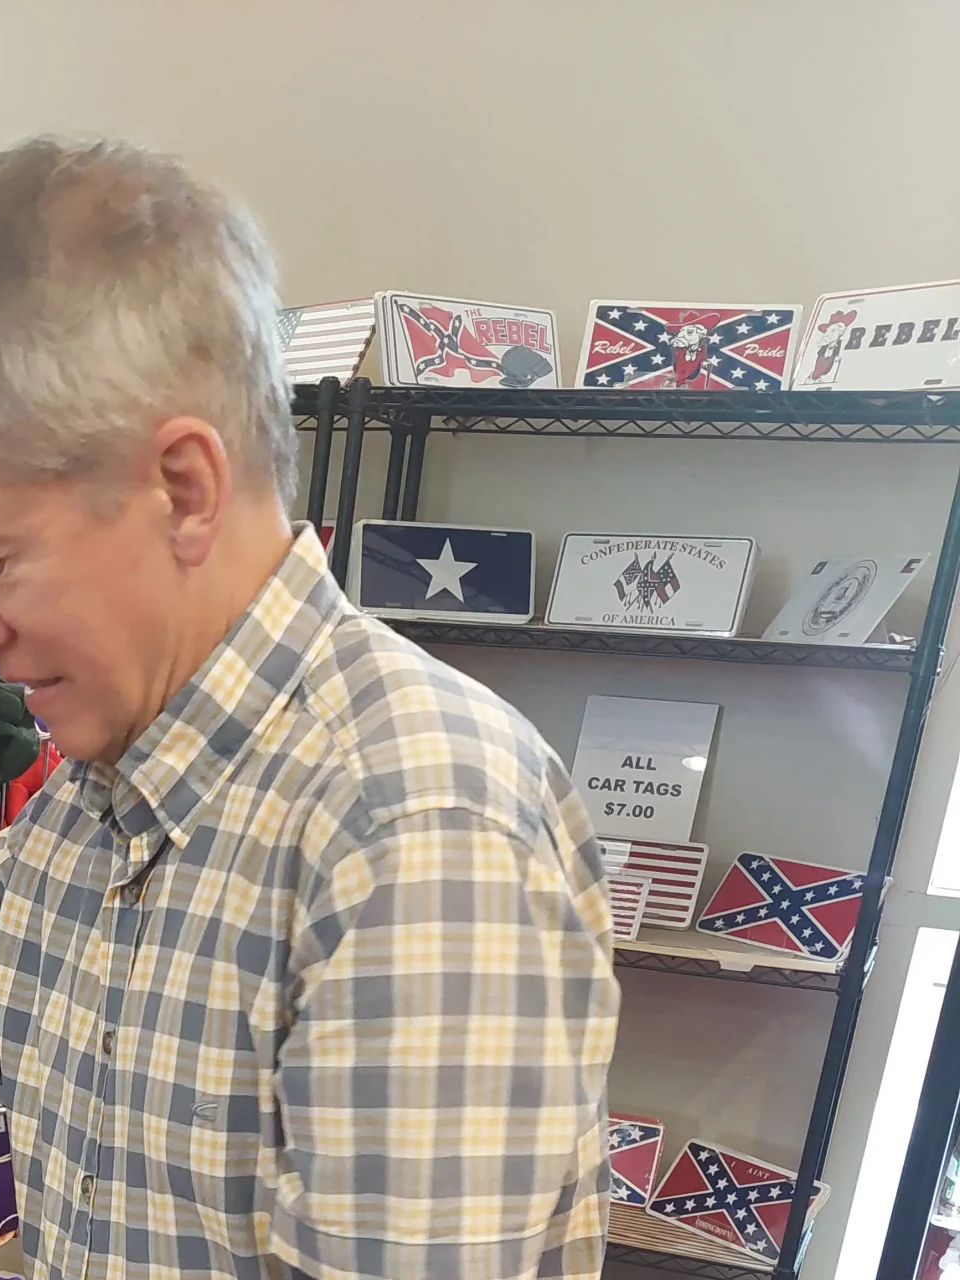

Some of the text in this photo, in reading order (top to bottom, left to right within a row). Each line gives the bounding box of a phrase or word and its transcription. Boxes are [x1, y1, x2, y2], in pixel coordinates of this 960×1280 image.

[464, 308, 483, 318] THE
[472, 317, 552, 354] REBEL
[844, 317, 960, 351] REBEL
[591, 340, 785, 358] Rebel Pride
[580, 539, 727, 570] CONFEDERATE STATES
[602, 613, 676, 626] OF AMERICA
[620, 755, 657, 771] ALL
[587, 776, 683, 798] CAR TAGS
[603, 801, 655, 819] $7.00
[746, 1167, 771, 1180] AINT
